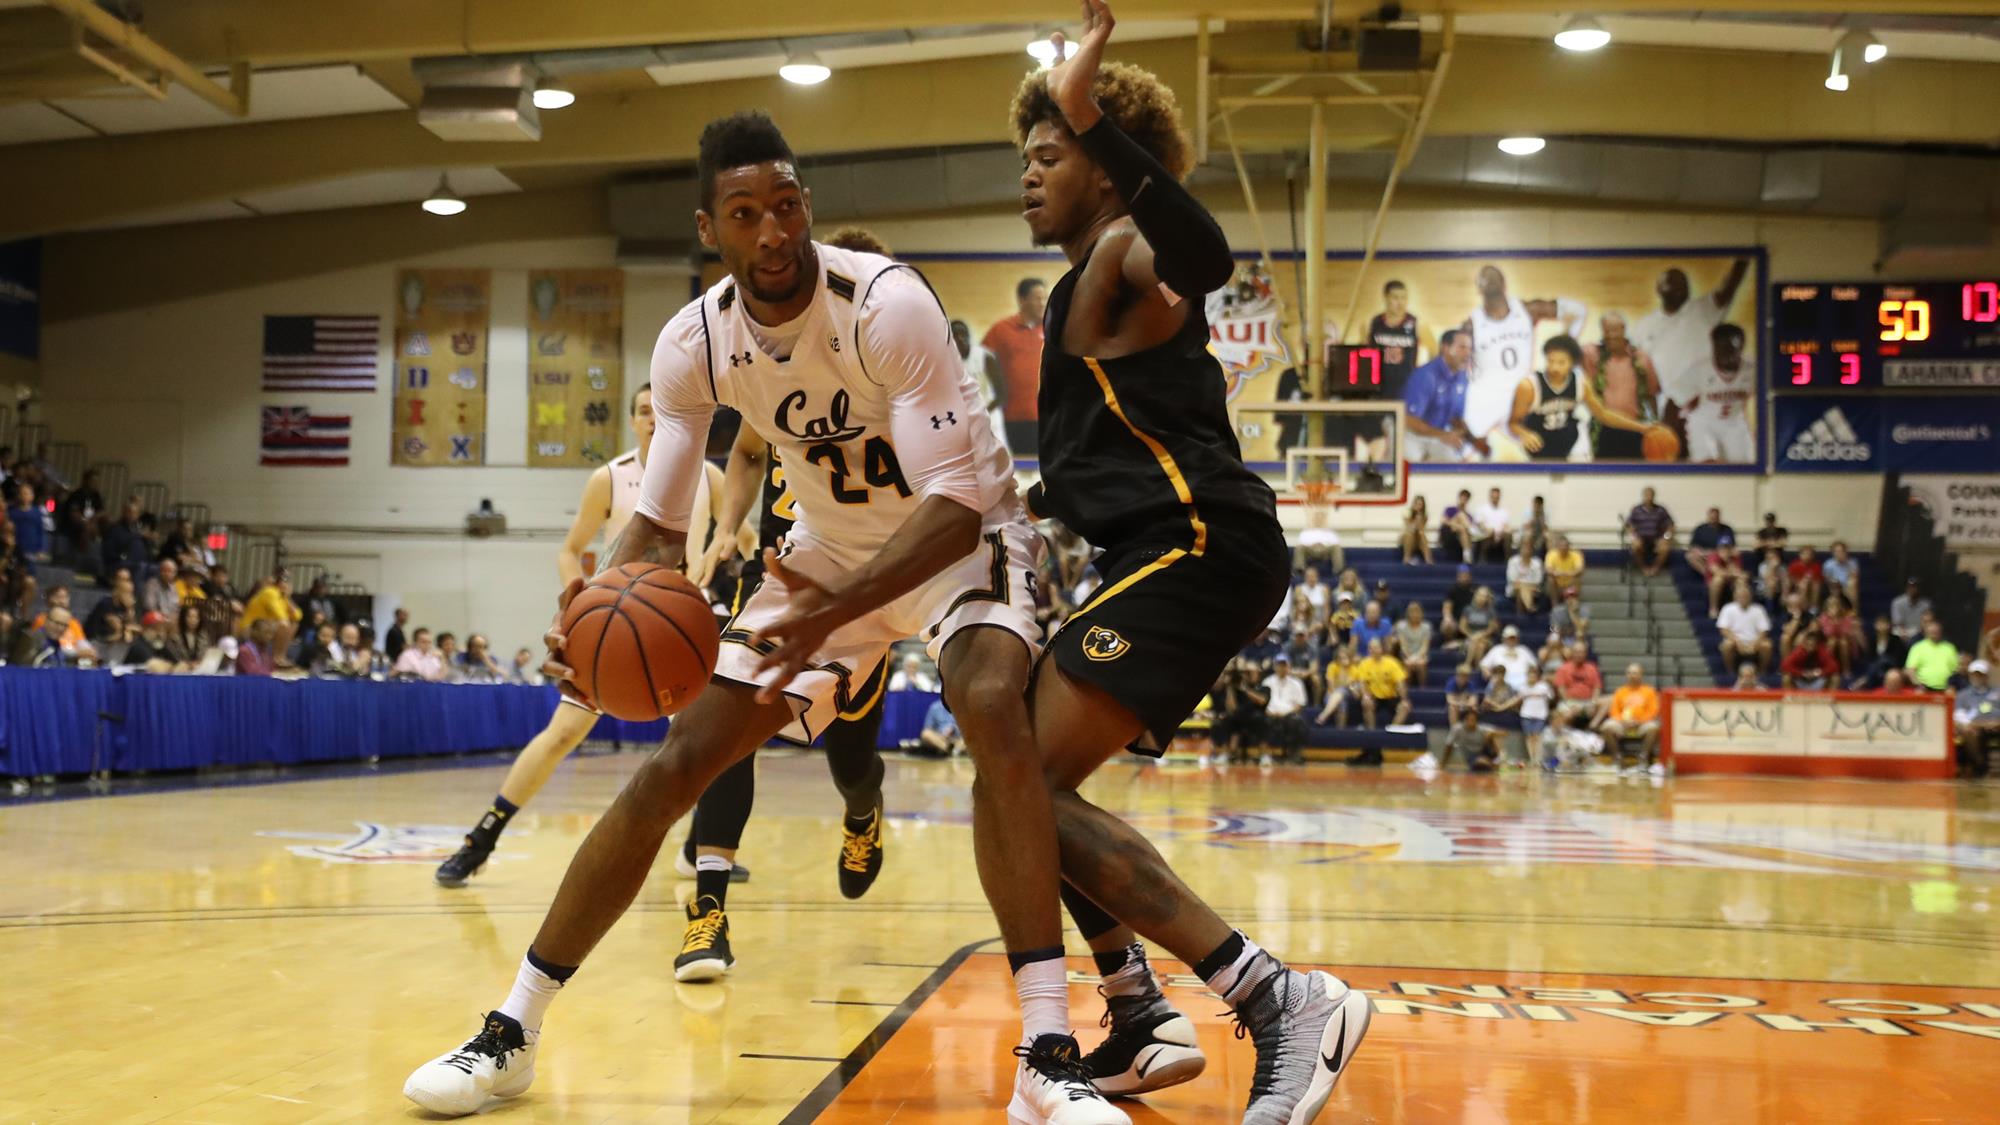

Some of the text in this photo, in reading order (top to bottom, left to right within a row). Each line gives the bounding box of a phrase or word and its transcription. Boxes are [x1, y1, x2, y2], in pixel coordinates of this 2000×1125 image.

[1879, 301, 1929, 341] 50
[1348, 348, 1381, 385] 17
[1791, 353, 1811, 385] 3
[1840, 353, 1861, 385] 3
[1885, 365, 1974, 382] LAHAINA
[774, 388, 866, 442] Cal
[805, 435, 913, 504] 24
[1786, 442, 1871, 461] adidas
[1690, 700, 1784, 741] MAUI
[1828, 700, 1926, 743] MAUI
